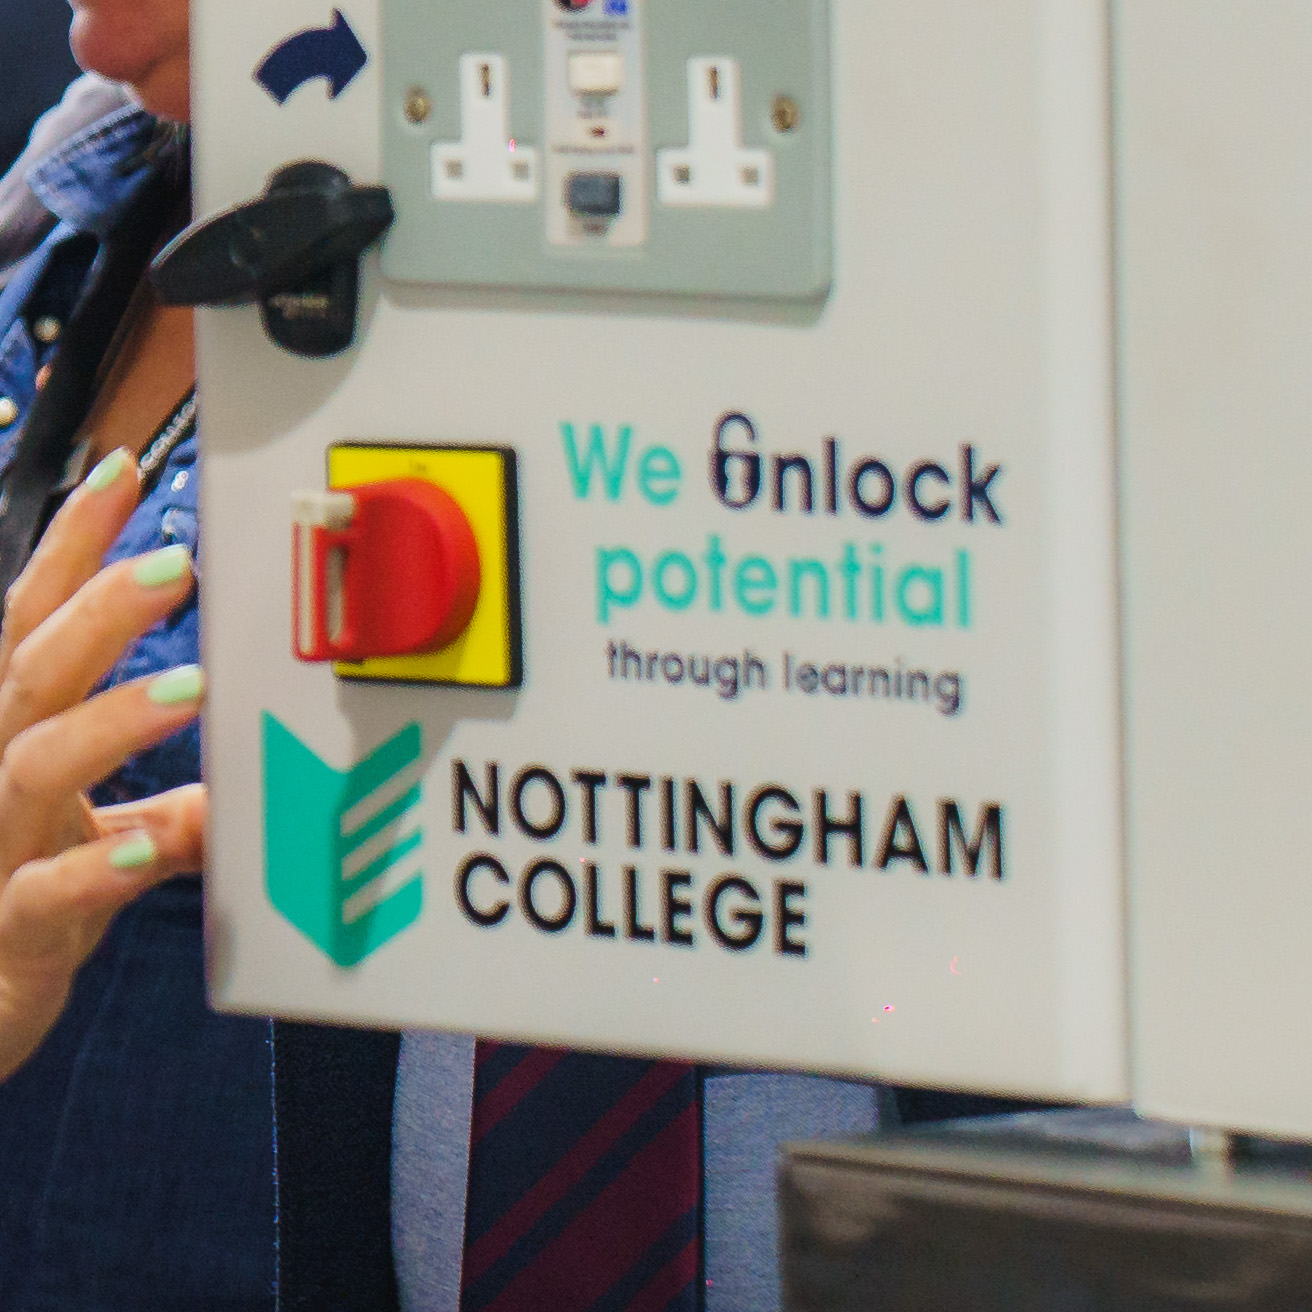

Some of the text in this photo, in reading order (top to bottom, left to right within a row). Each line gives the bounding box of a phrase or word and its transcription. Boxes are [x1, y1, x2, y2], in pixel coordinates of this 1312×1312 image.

[560, 422, 683, 506] We
[595, 534, 973, 629] potential
[606, 639, 963, 716] through learning
[450, 757, 1005, 883] NOTTINGHAM
[452, 851, 809, 958] COLLEGE
